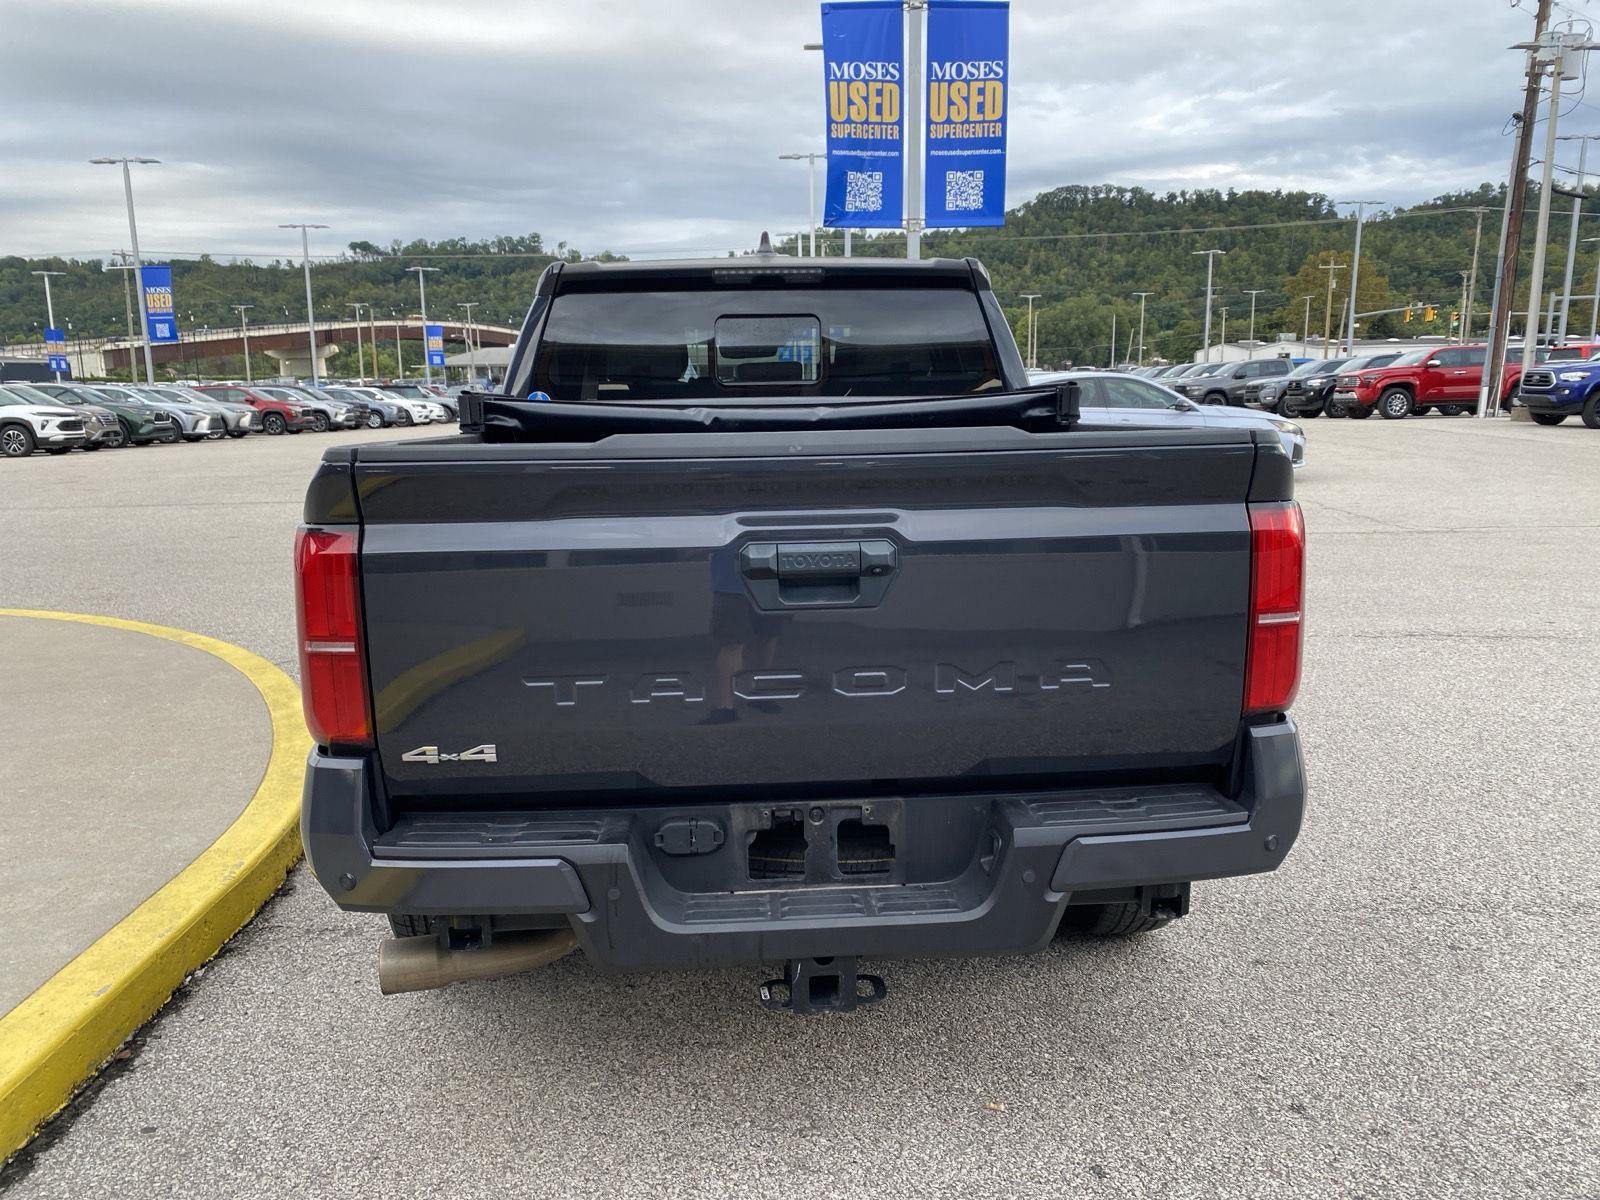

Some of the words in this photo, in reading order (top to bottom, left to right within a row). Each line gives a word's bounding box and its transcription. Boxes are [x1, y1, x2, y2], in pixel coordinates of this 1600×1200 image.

[829, 62, 900, 80] MOSES
[931, 61, 1003, 80] MOSES
[829, 81, 900, 123] USED
[930, 81, 1003, 123] USED
[831, 124, 899, 139] SUPERCENTER
[930, 123, 1002, 139] SUPERCENTER
[146, 293, 173, 308] USED
[782, 553, 857, 568] TOYOTA
[522, 658, 1112, 706] TACOMA
[402, 744, 498, 764] 4x4
